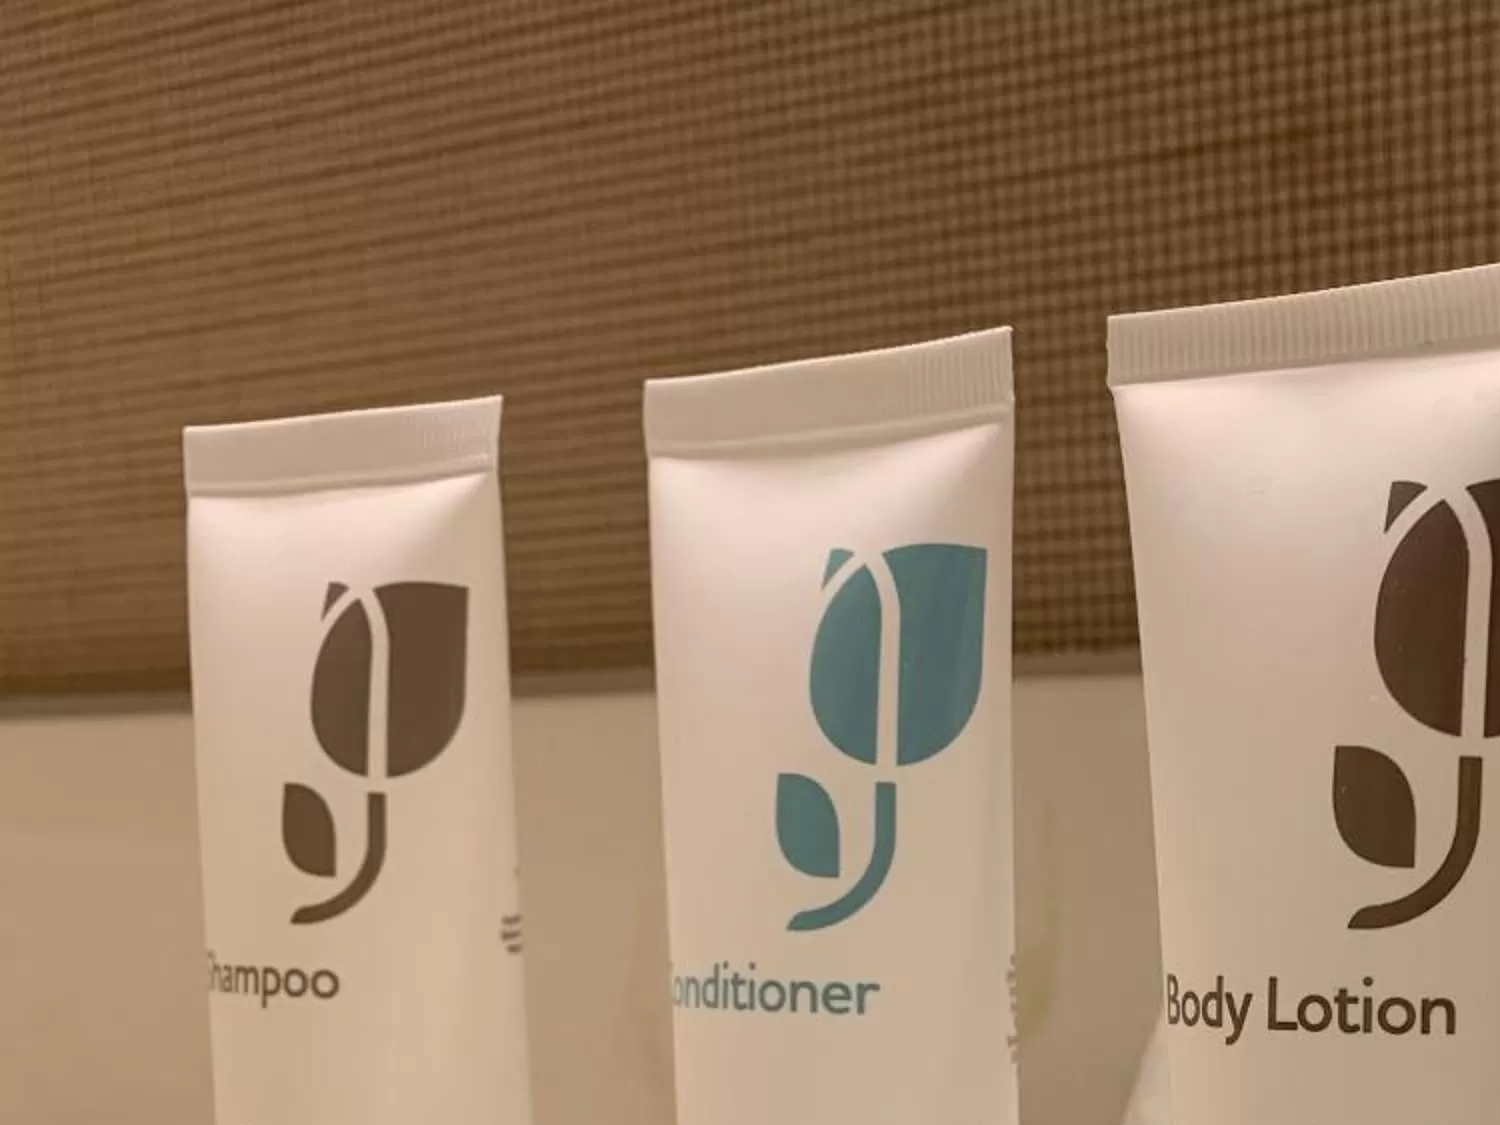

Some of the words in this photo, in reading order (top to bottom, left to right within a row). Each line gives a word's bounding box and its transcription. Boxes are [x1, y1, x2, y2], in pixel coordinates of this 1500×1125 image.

[207, 949, 340, 1009] hampoo
[671, 959, 881, 1016] onditioner
[1167, 973, 1253, 1046] Body
[1267, 976, 1457, 1035] Lotion
